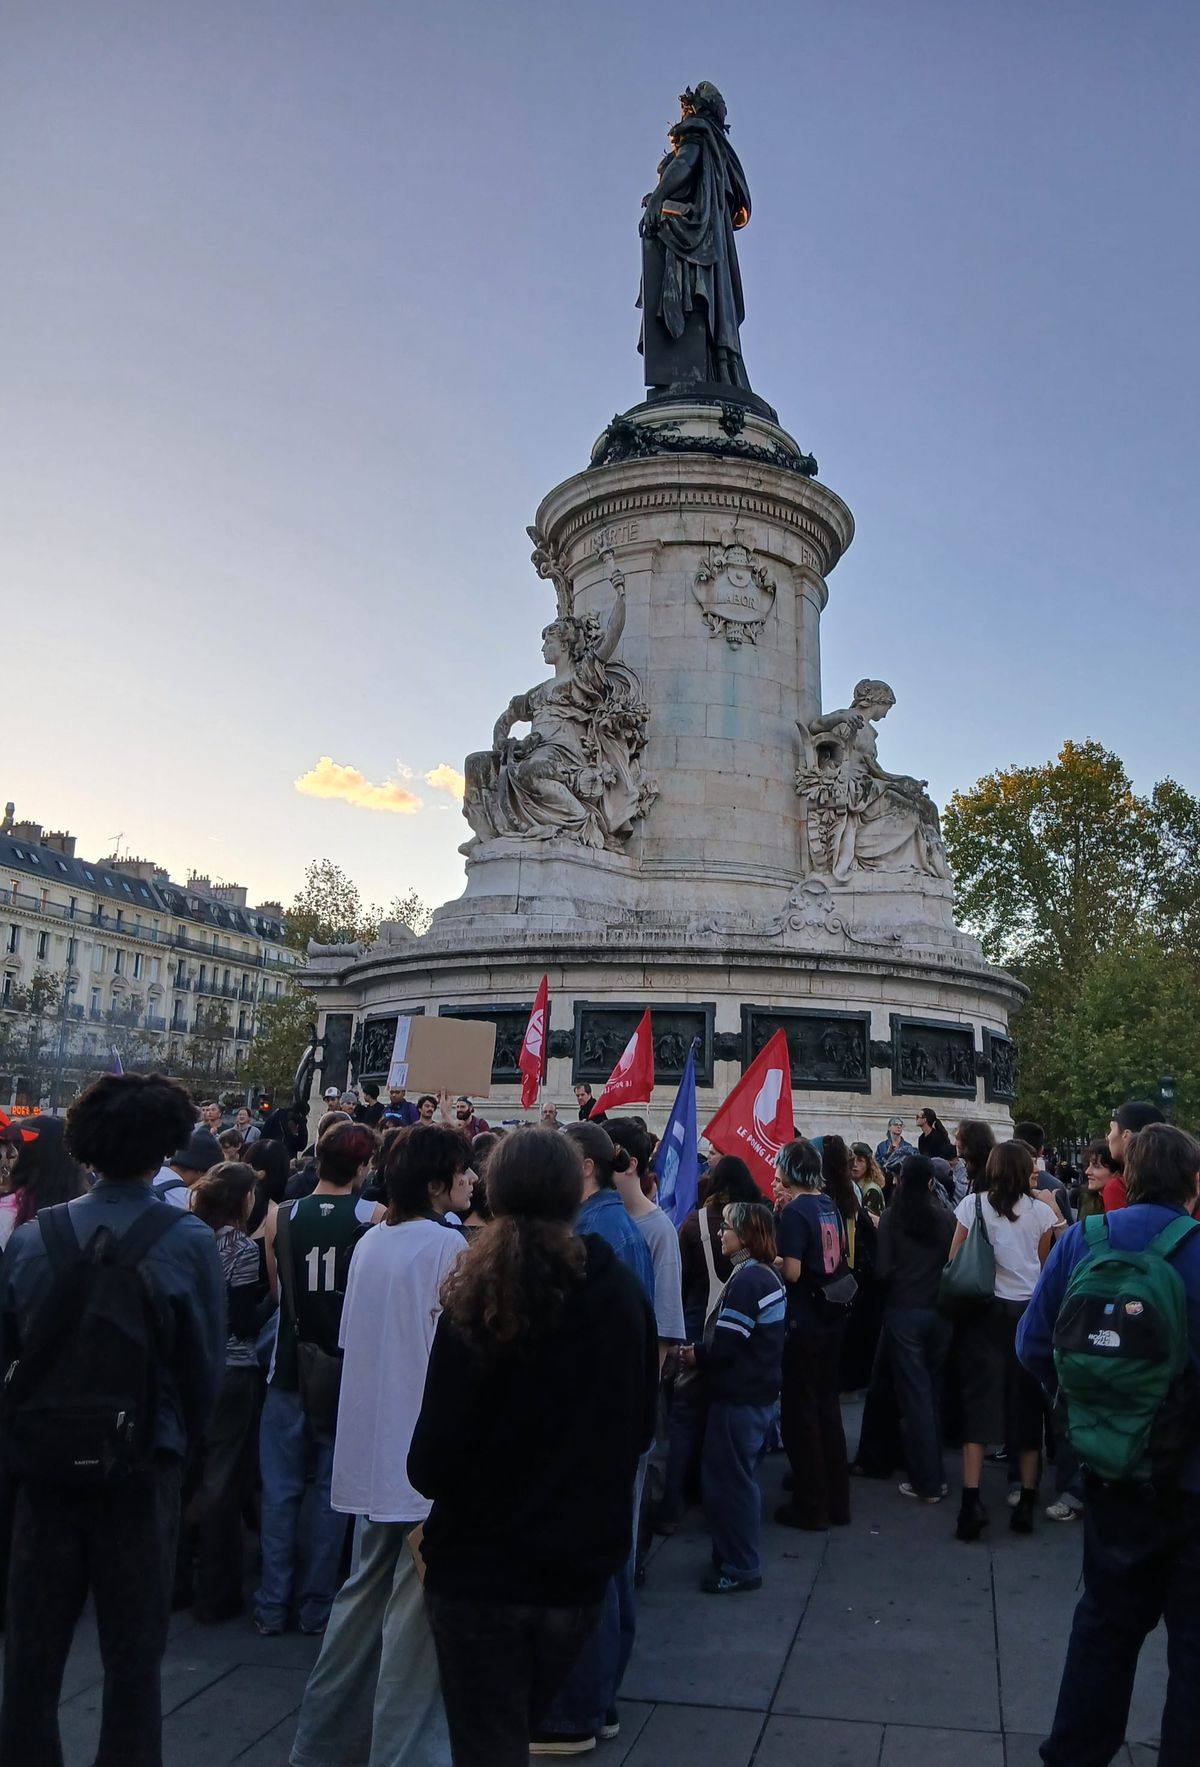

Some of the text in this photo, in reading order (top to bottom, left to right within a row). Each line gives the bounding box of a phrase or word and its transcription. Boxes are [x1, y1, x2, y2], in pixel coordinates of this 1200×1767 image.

[736, 1125, 748, 1138] LE
[746, 1134, 766, 1157] POING
[305, 1246, 336, 1291] 11
